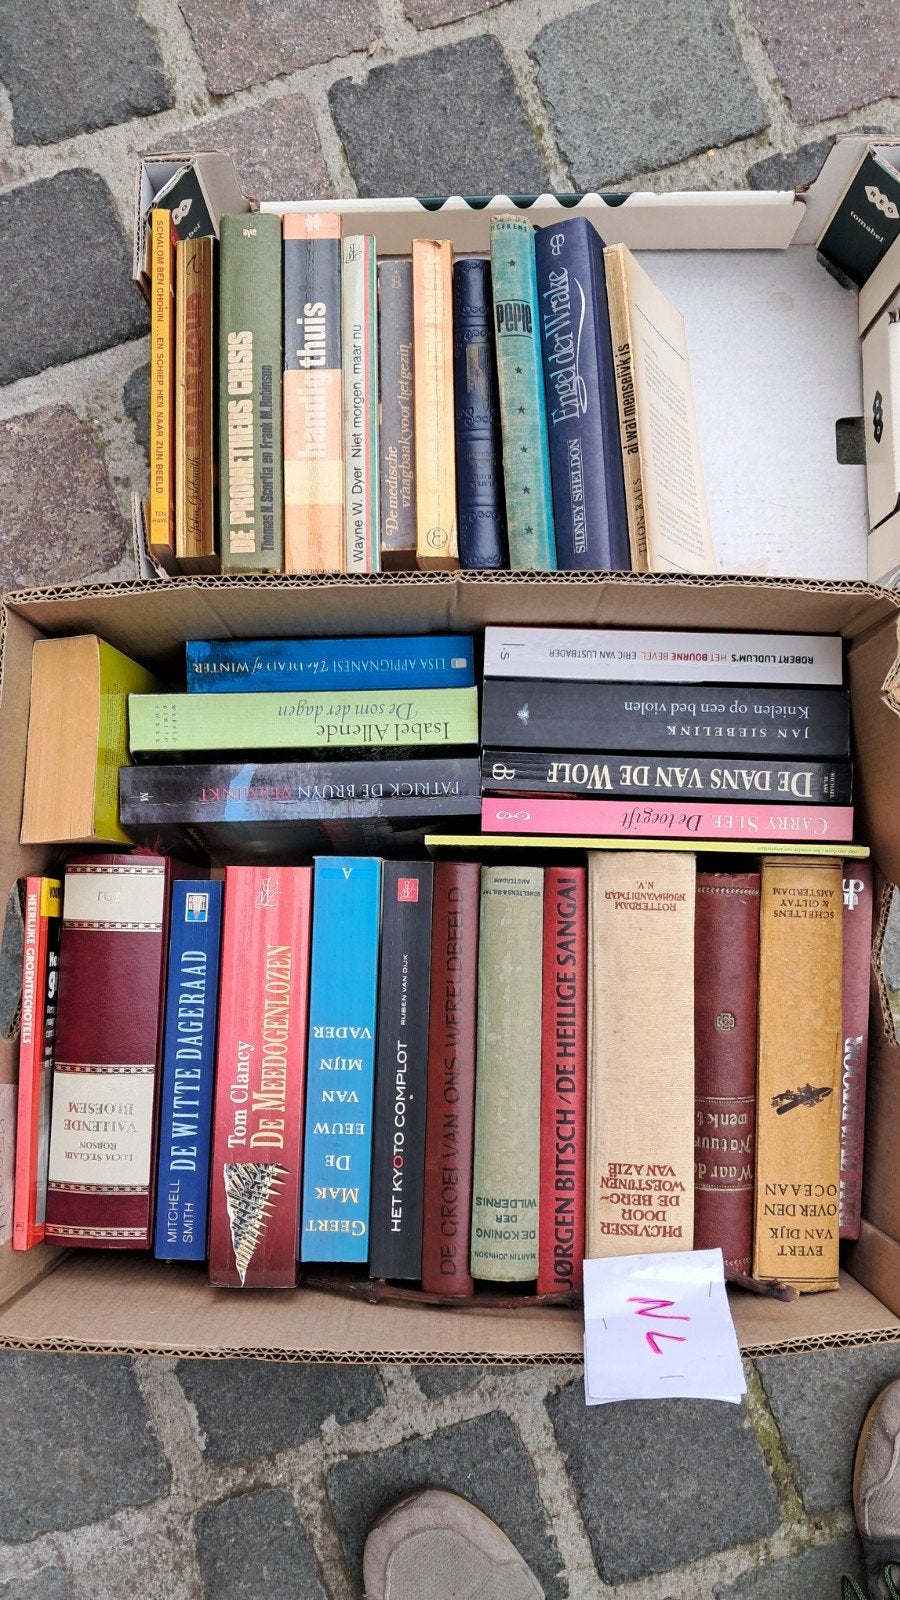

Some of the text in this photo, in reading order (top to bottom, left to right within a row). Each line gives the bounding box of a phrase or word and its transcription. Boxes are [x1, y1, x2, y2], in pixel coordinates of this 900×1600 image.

[849, 210, 885, 243] tomabel
[542, 267, 572, 340] Wrake
[155, 219, 165, 494] SCHALOM BEN CHORIN SCHIEP HEN NAAR ZIJN BEELD
[549, 331, 576, 364] der
[615, 343, 631, 359] is
[296, 301, 333, 459] handig thuis
[549, 363, 581, 426] Engel
[397, 342, 414, 508] vraagbaak voor het gezin
[227, 330, 256, 554] DE PROMETHEUS CRISIS
[351, 324, 366, 563] Wayne W. Dyer Niet morgen, maar nu
[260, 422, 275, 552] Thomas en Frank
[384, 445, 398, 536] De medische
[568, 439, 586, 554] SIDNEY SHELDON
[193, 656, 447, 675] LISA APPIGNANESI The of WINTER
[549, 649, 814, 665] ROBERT LUDLUM'S HET BOURNE BEVEL ERIC VAN LUSTBADER
[277, 699, 418, 724] De som der dagen
[623, 700, 810, 719] Knielen op een bed violen
[316, 722, 450, 743] Isabel Allende
[666, 725, 810, 739] JAN SIEBELINK
[546, 762, 814, 798] DE DANS VAN DE WOLF
[198, 781, 460, 802] PATRICK DE BRUYN VERMINKT
[621, 806, 829, 836] CARRY SLEE De toegift
[493, 877, 531, 885] AMSTERDAM
[772, 887, 835, 897] AMSTERDAM
[614, 901, 677, 912] ROTTERDAM
[779, 898, 819, 908] GILTAY
[773, 909, 835, 919] SCHELTENS
[22, 893, 38, 1045] HEERLIJKE GROENTESCHOTELS
[401, 953, 409, 974] DIJK
[400, 995, 408, 1026] RUBEN
[312, 1026, 373, 1040] VADER
[250, 944, 294, 1150] DE MEEDOGENLOZEN
[169, 950, 208, 1172] DE WITTE DAGERAAD
[319, 1057, 364, 1071] MIJN
[440, 886, 465, 1277] DE GROEI VAN ONS WERELDBEELD
[553, 877, 578, 1290] JØRGEN BITSCH DE HEILIGE SANGAI
[227, 1040, 256, 1149] Tom Clancy
[321, 1089, 360, 1103] VAN
[67, 1101, 135, 1116] BLOESEM
[63, 1118, 137, 1134] VALLENDE
[312, 1121, 366, 1136] EEUW
[390, 1039, 408, 1232] HET KYOTO COMPLOT
[79, 1141, 117, 1151] ROBSON
[105, 1152, 133, 1162] LUCIA
[325, 1154, 352, 1172] DE
[607, 1162, 677, 1178] VAN AZIË
[711, 1164, 753, 1182] Waar
[314, 1187, 360, 1204] MAK
[600, 1193, 681, 1207] DE BERG-
[765, 1183, 838, 1198] OCEAAN
[166, 1178, 181, 1244] MITCHELL
[475, 1196, 538, 1209] WILDERNIS
[763, 1202, 838, 1217] OVER DEN
[182, 1202, 194, 1244] SMITH
[495, 1214, 518, 1223] DER
[620, 1208, 667, 1222] DOOR
[305, 1218, 367, 1237] GEERT
[475, 1226, 536, 1241] DE KONING
[768, 1226, 834, 1240] VAN DIJK
[474, 1250, 537, 1261] MARTIN JOHNSON
[777, 1245, 824, 1257] EVERT
